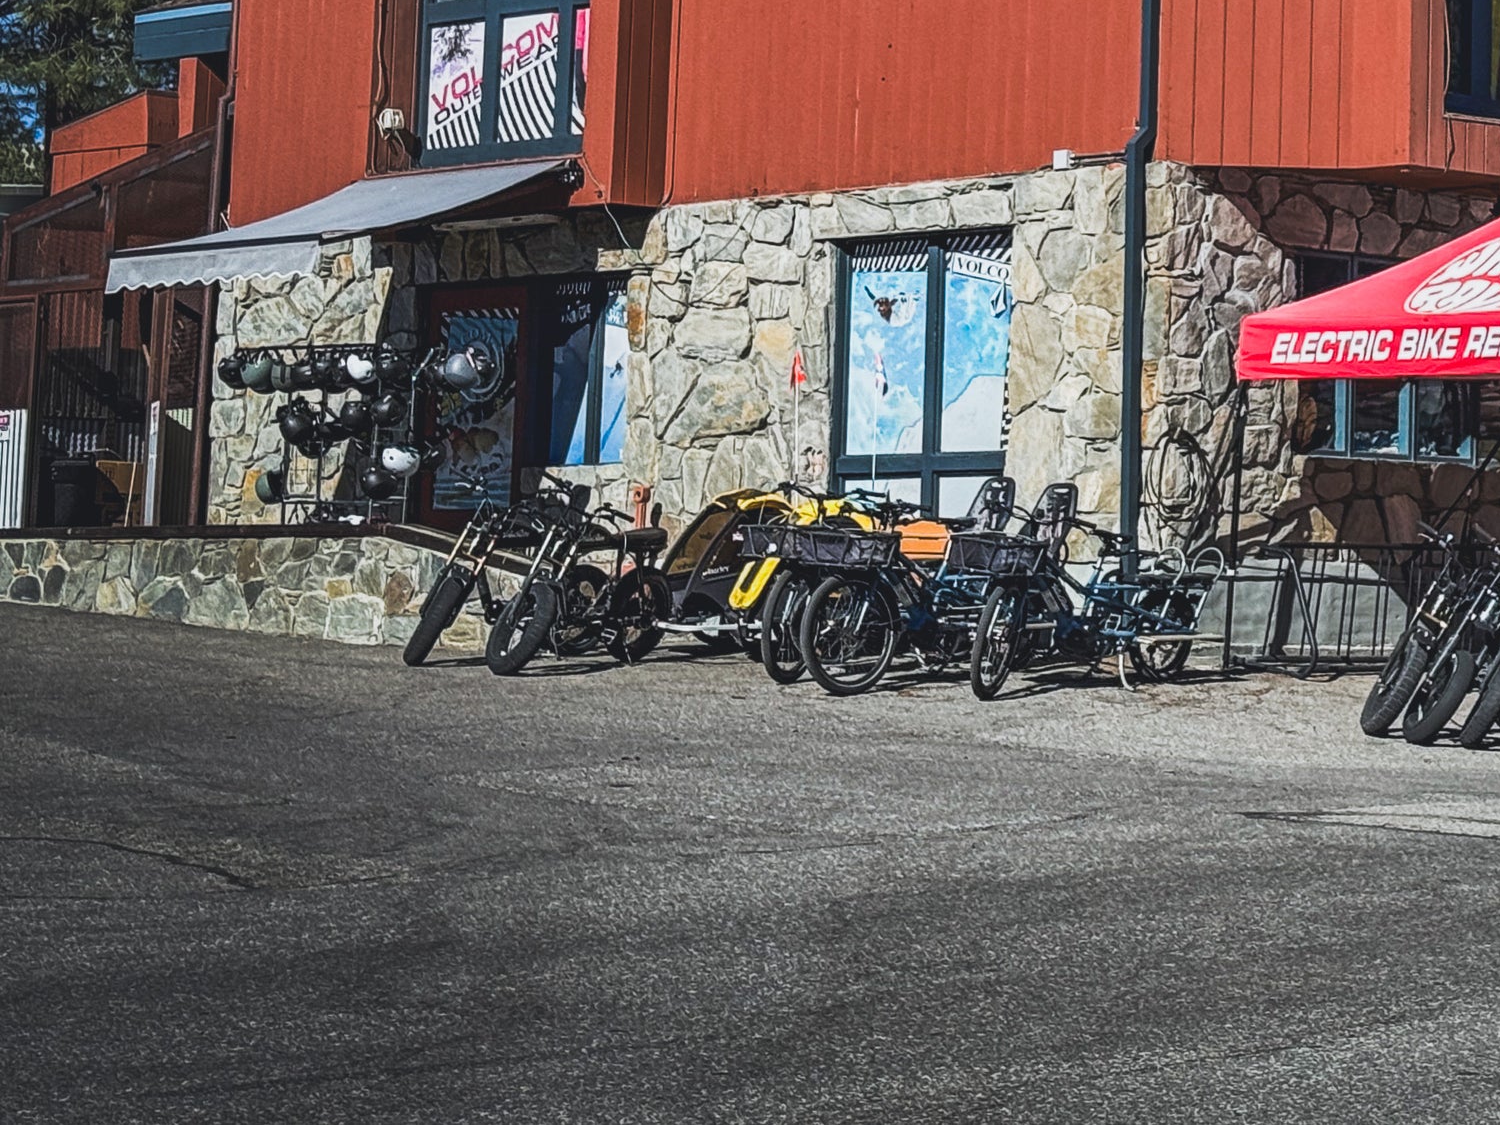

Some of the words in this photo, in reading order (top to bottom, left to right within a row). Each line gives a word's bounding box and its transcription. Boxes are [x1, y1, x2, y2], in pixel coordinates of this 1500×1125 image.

[957, 256, 1010, 280] VOLCO
[1270, 329, 1393, 364] ELECTRIC
[1397, 326, 1461, 360] BIKE
